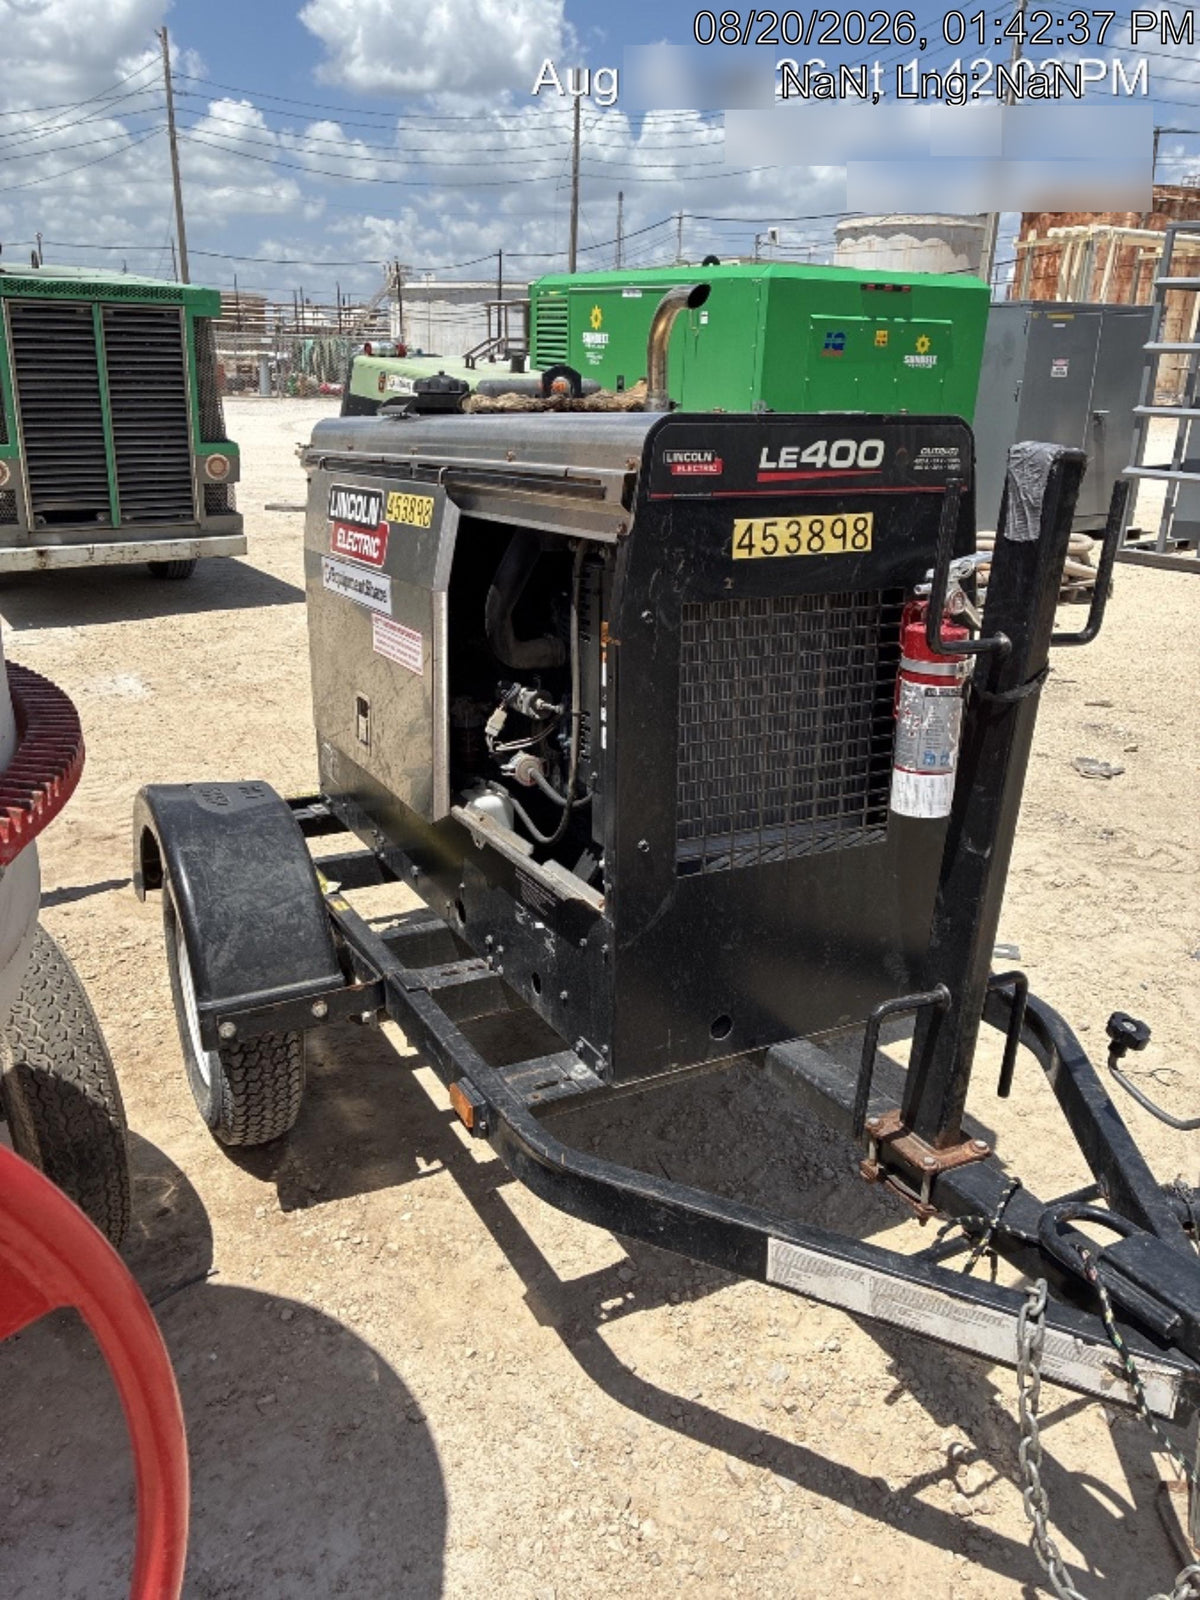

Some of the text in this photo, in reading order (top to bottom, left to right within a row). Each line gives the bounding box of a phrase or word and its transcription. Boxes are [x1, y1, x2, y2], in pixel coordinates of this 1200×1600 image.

[666, 452, 712, 463] LINCOLN
[758, 438, 885, 468] LE400
[330, 490, 380, 526] LINCOLN
[337, 527, 381, 559] ELECTRIC
[735, 516, 869, 556] 453898
